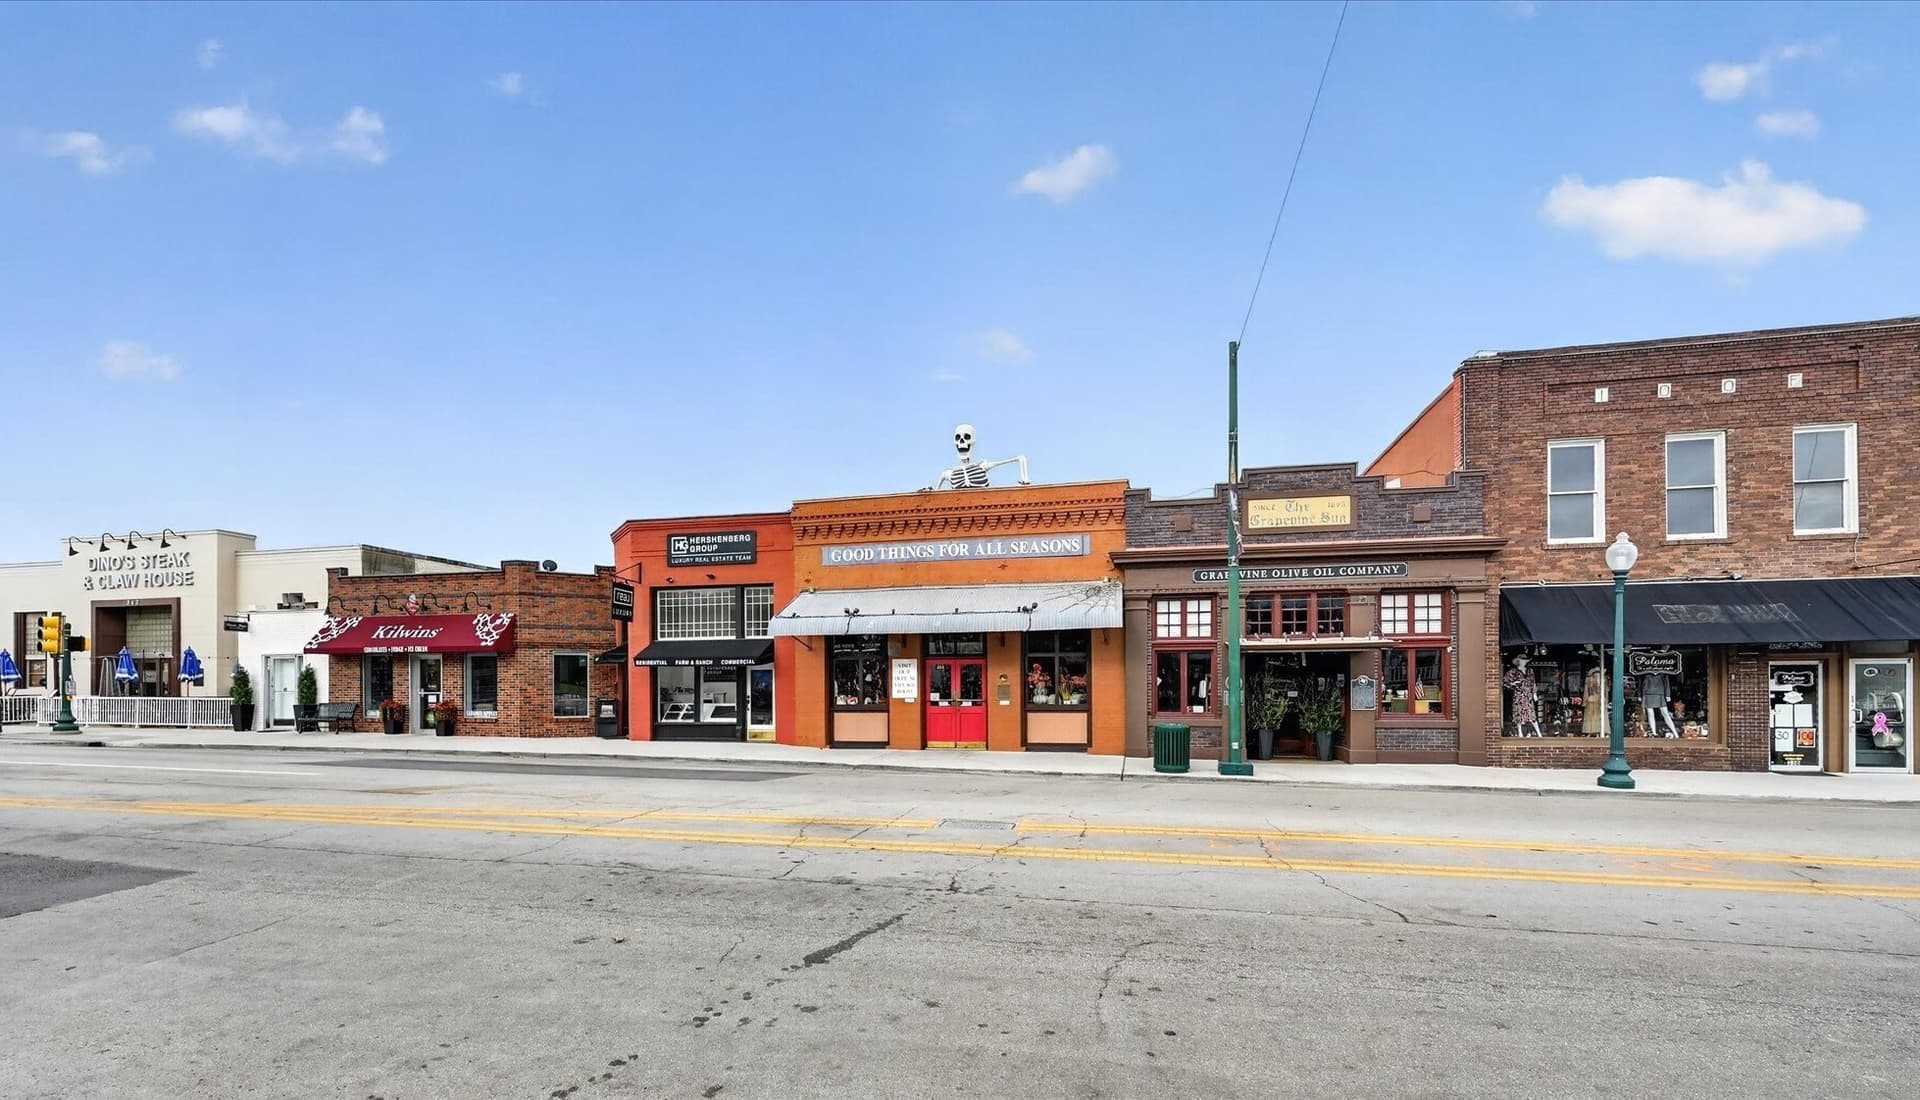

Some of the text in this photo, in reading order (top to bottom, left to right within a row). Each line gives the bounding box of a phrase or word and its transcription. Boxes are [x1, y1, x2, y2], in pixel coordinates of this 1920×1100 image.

[1284, 500, 1310, 513] The
[1250, 512, 1347, 527] Grapevine Sun
[689, 534, 751, 545] HERSHENBERG
[689, 544, 718, 553] GROUP
[831, 538, 1081, 562] GOOD THINGS FOR ALL SEASONS
[89, 552, 190, 572] DINO'S STEAK
[1200, 565, 1400, 580] GRAPVINE OLIVE OIL COMPANY
[84, 571, 195, 590] & CLAW HOUSE
[1635, 656, 1675, 666] Paloma
